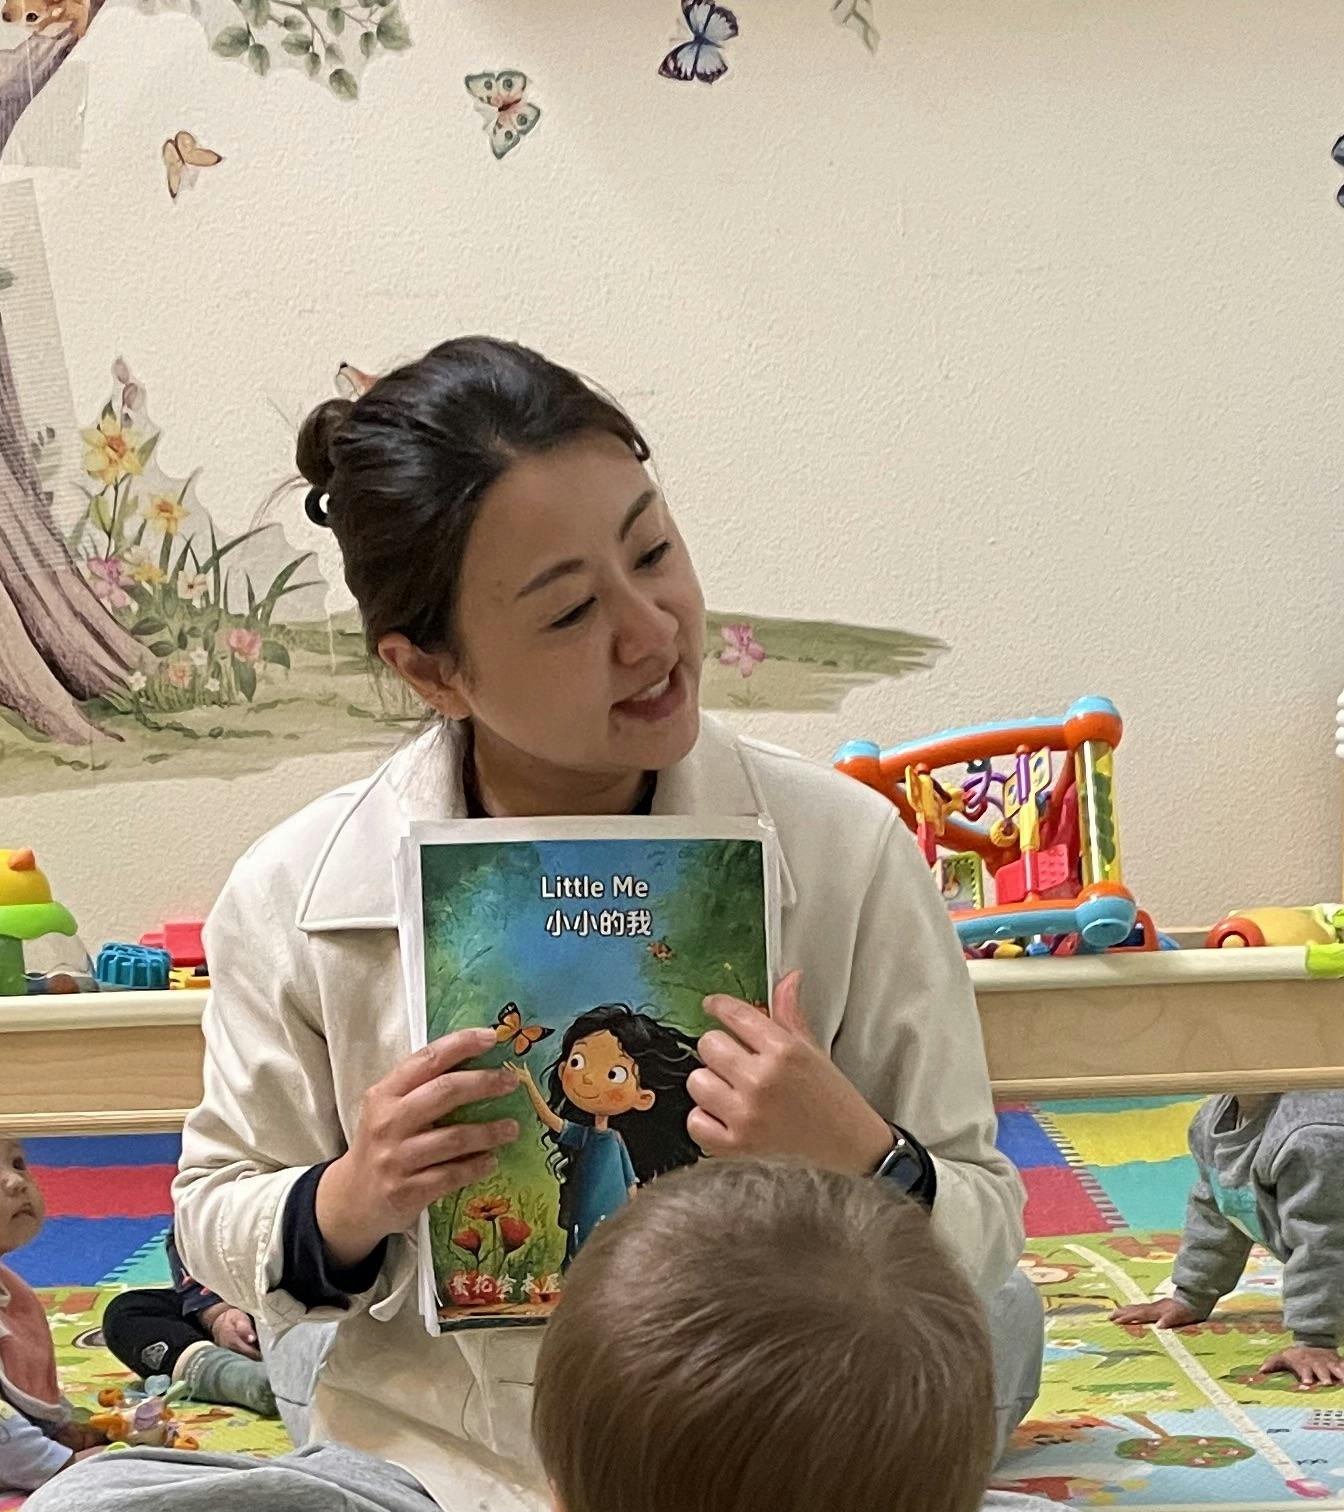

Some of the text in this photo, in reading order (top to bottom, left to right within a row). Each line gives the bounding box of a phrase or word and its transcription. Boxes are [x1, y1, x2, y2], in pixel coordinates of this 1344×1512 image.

[541, 875, 649, 898] Little Me
[545, 909, 652, 937] 小小的我
